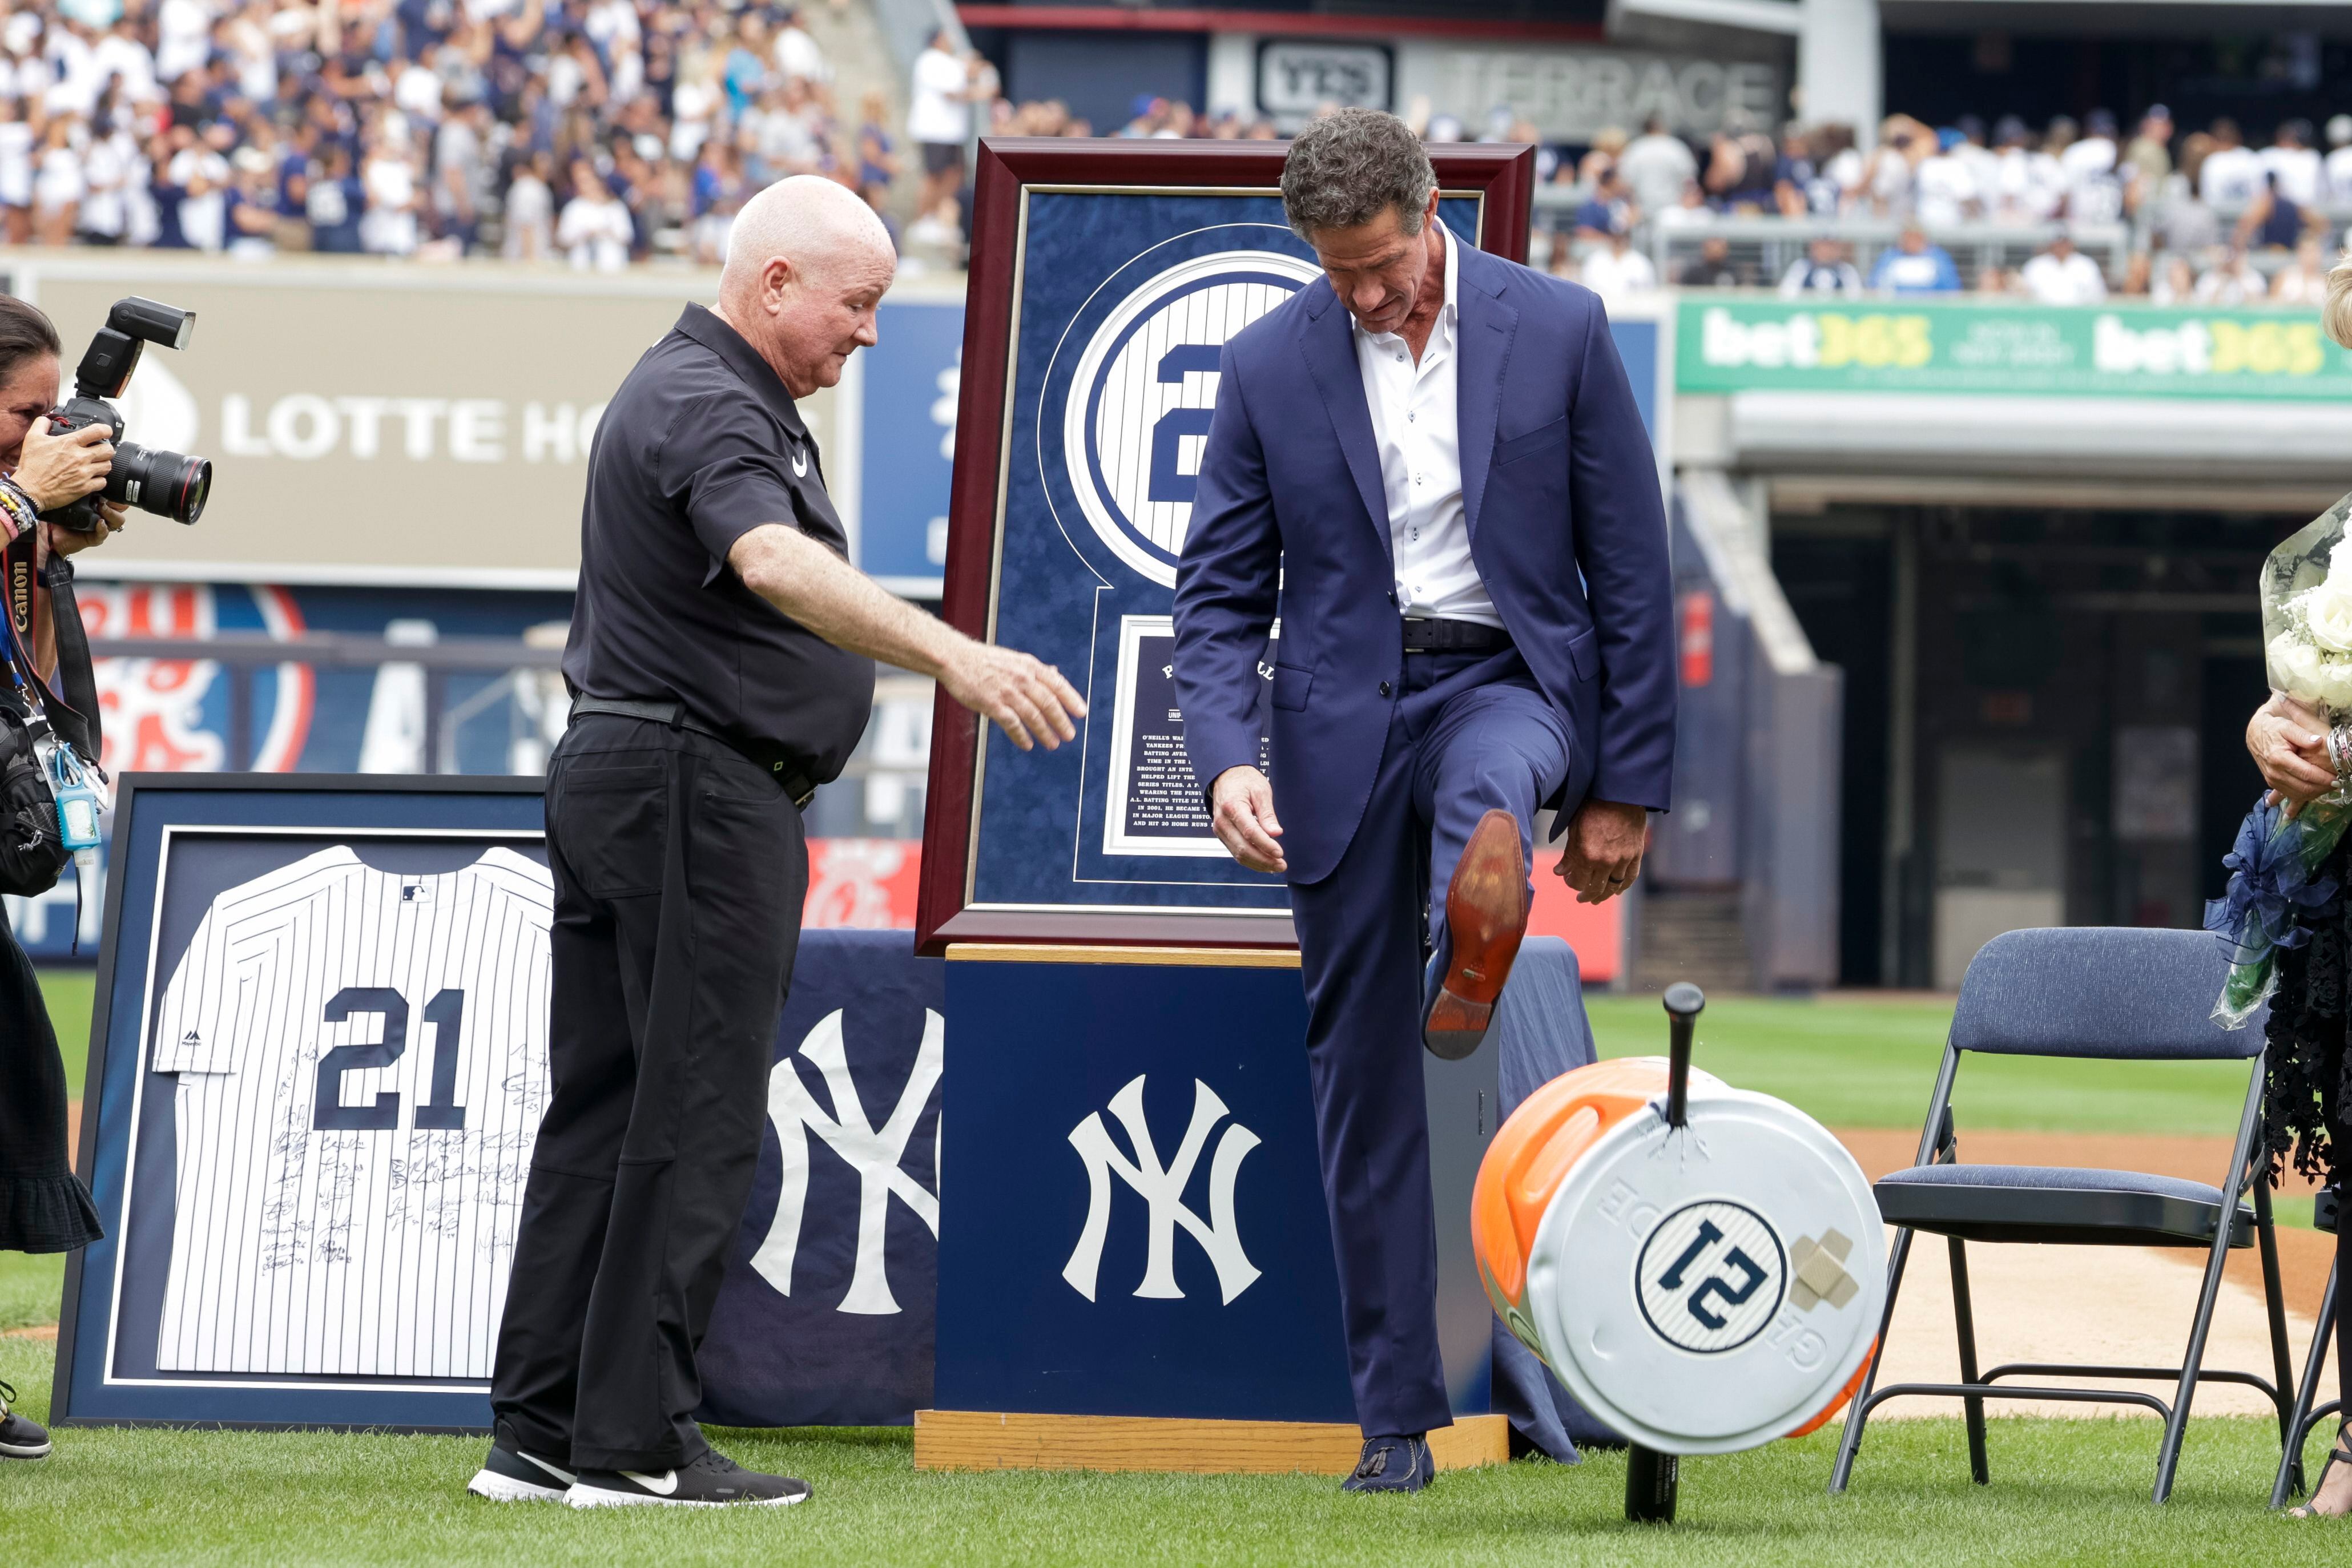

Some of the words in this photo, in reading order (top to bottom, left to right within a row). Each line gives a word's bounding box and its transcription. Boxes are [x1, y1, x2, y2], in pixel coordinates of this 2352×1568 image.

[1445, 54, 1777, 129] TERRACE
[1703, 308, 1931, 368] bet365
[2094, 315, 2325, 374] bet365
[221, 393, 505, 462] LOTTE
[14, 562, 27, 633] Canon
[313, 987, 465, 1130] 21
[1062, 1074, 1262, 1306] NY
[1658, 1219, 1769, 1331] 21
